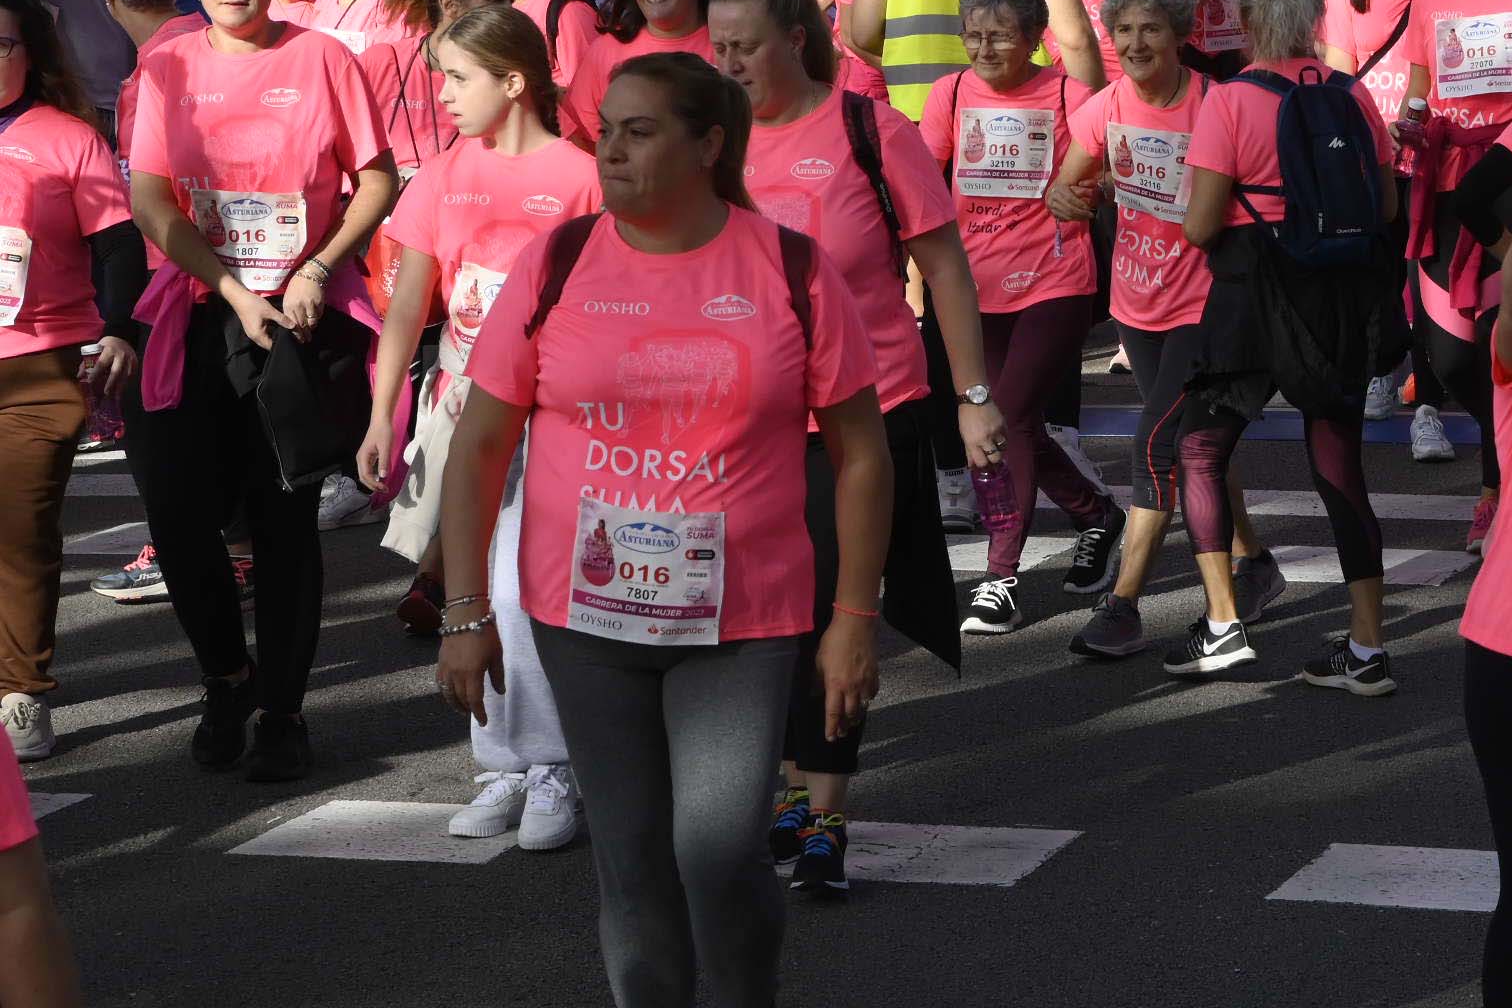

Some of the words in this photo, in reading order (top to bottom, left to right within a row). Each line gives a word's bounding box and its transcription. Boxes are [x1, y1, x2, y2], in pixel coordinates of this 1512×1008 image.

[1467, 45, 1496, 58] 016
[989, 144, 1019, 156] 016
[990, 160, 1015, 168] 32119
[1137, 163, 1166, 179] 016
[1140, 179, 1161, 191] 32116
[444, 193, 490, 206] OYSHO
[226, 206, 268, 216] ASTURIANA
[229, 229, 266, 243] 016
[237, 247, 259, 256] 1807
[584, 300, 650, 316] OYSHO
[704, 305, 753, 316] ASTURIANA
[577, 401, 624, 431] TU
[585, 439, 728, 482] DORSAL
[619, 531, 675, 548] ASTURIANA
[686, 532, 715, 540] SUMA
[620, 562, 670, 584] 016
[626, 587, 658, 601] 7807
[586, 596, 622, 610] CARRERA
[625, 604, 637, 612] DE
[639, 605, 650, 614] LA
[652, 606, 682, 617] MUJER
[581, 613, 622, 630] OYSHO
[660, 625, 706, 635] Santander
